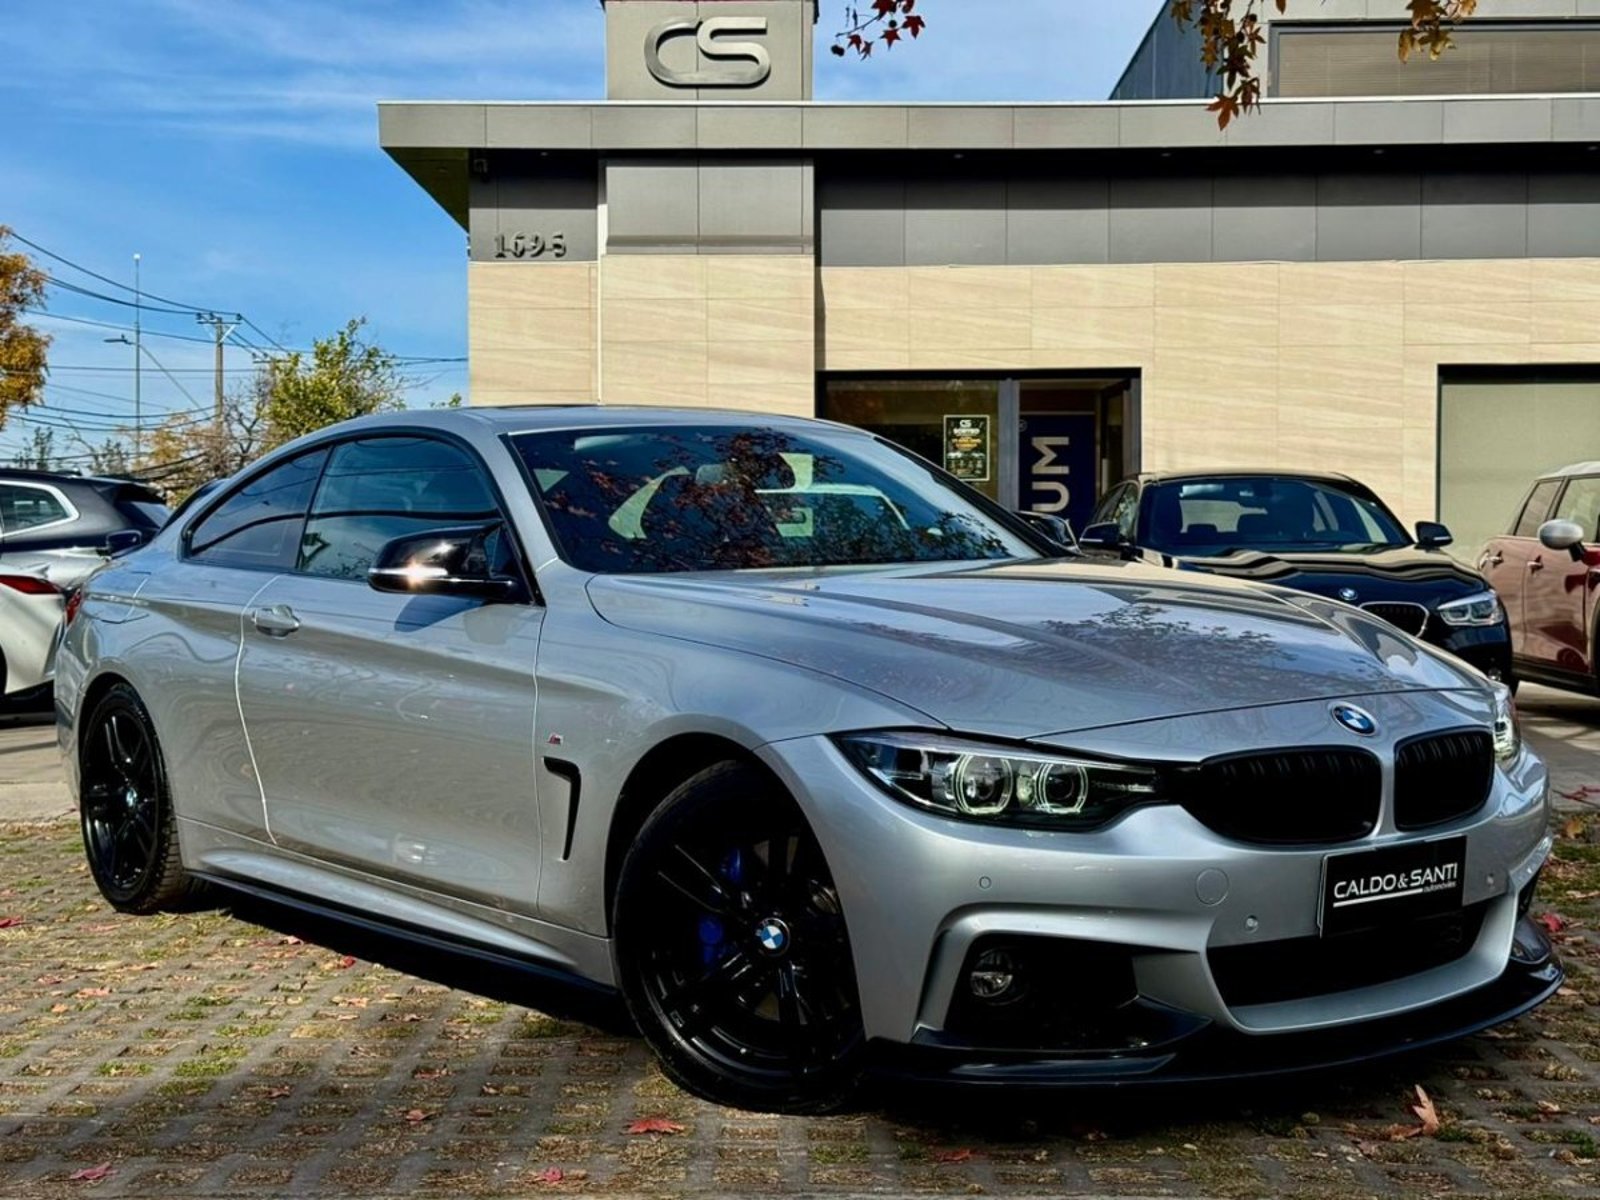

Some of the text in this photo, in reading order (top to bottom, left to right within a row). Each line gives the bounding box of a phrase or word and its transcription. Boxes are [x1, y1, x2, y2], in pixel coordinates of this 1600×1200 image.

[643, 16, 771, 88] CS
[494, 231, 567, 258] 1695
[1334, 862, 1458, 899] CALDO&SANTI
